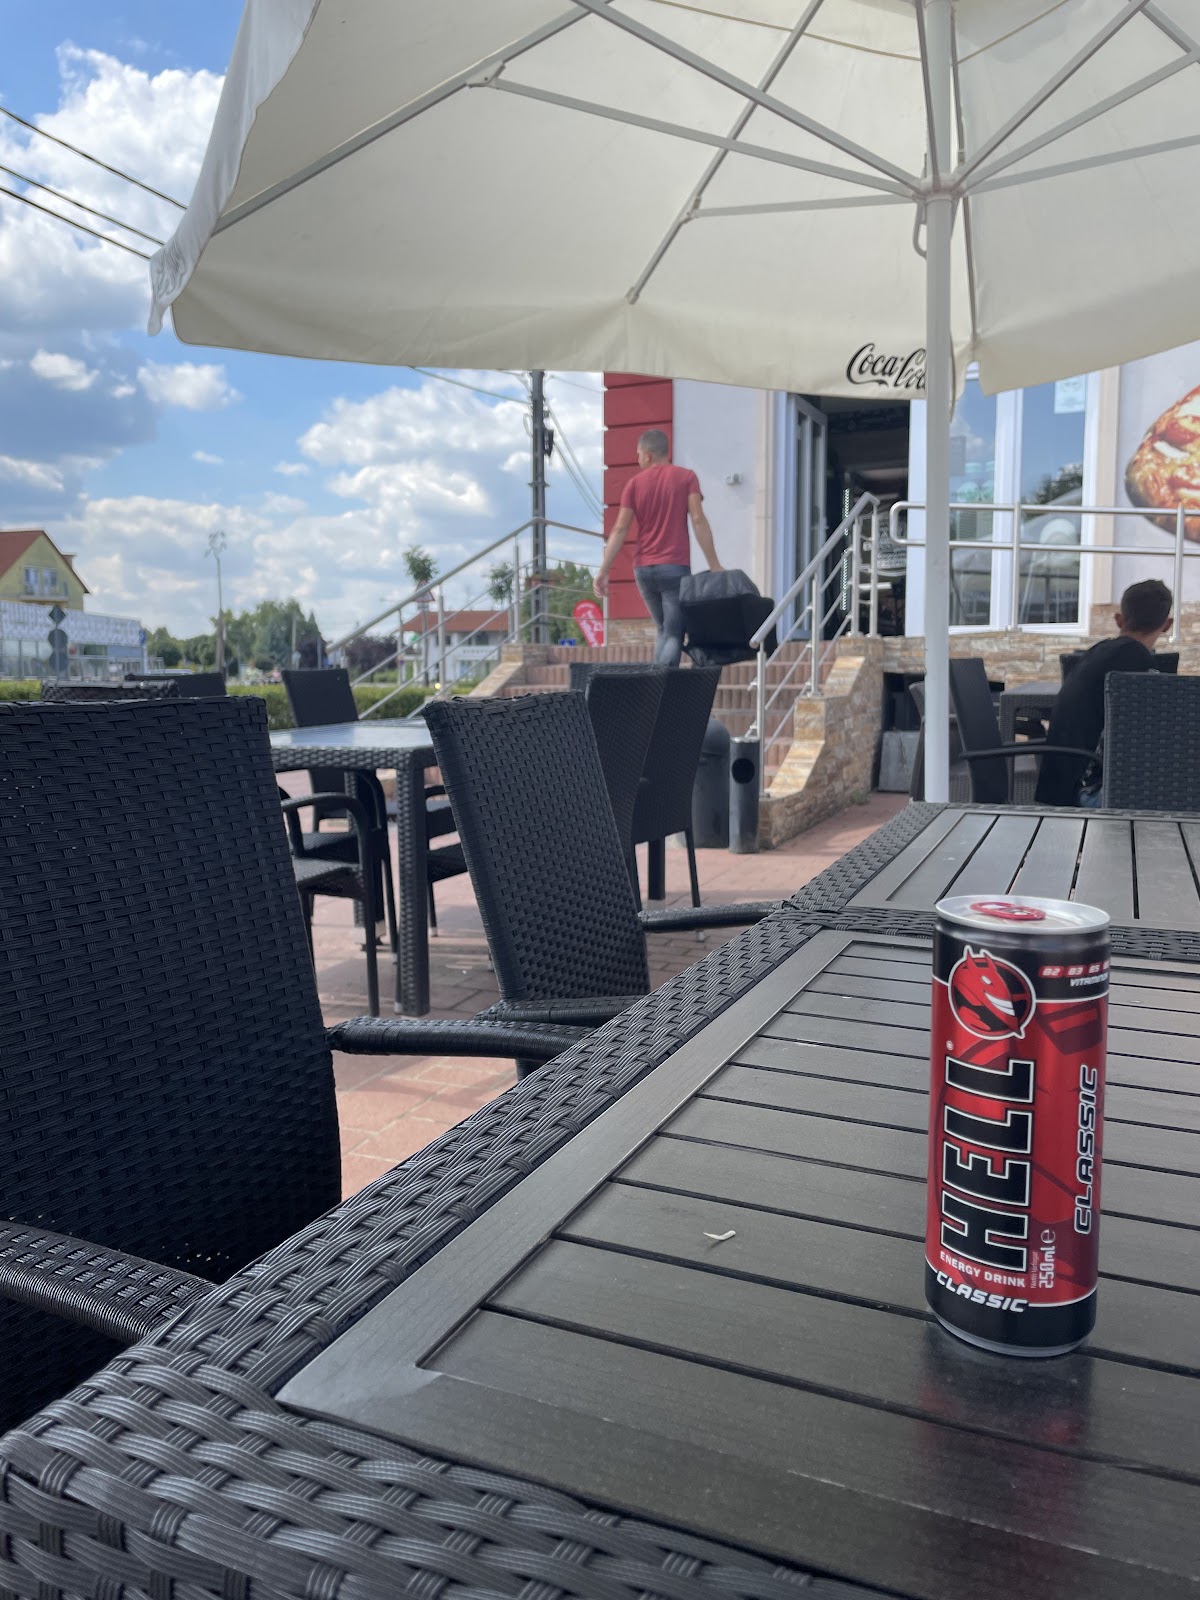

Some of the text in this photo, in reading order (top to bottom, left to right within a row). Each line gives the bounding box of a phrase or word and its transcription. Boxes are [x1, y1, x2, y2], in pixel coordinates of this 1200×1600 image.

[941, 1056, 1035, 1272] HELL
[1074, 1064, 1098, 1235] CLASSIC
[936, 1270, 1029, 1313] CLASSIC
[939, 1250, 1026, 1288] ENERGY DRINK
